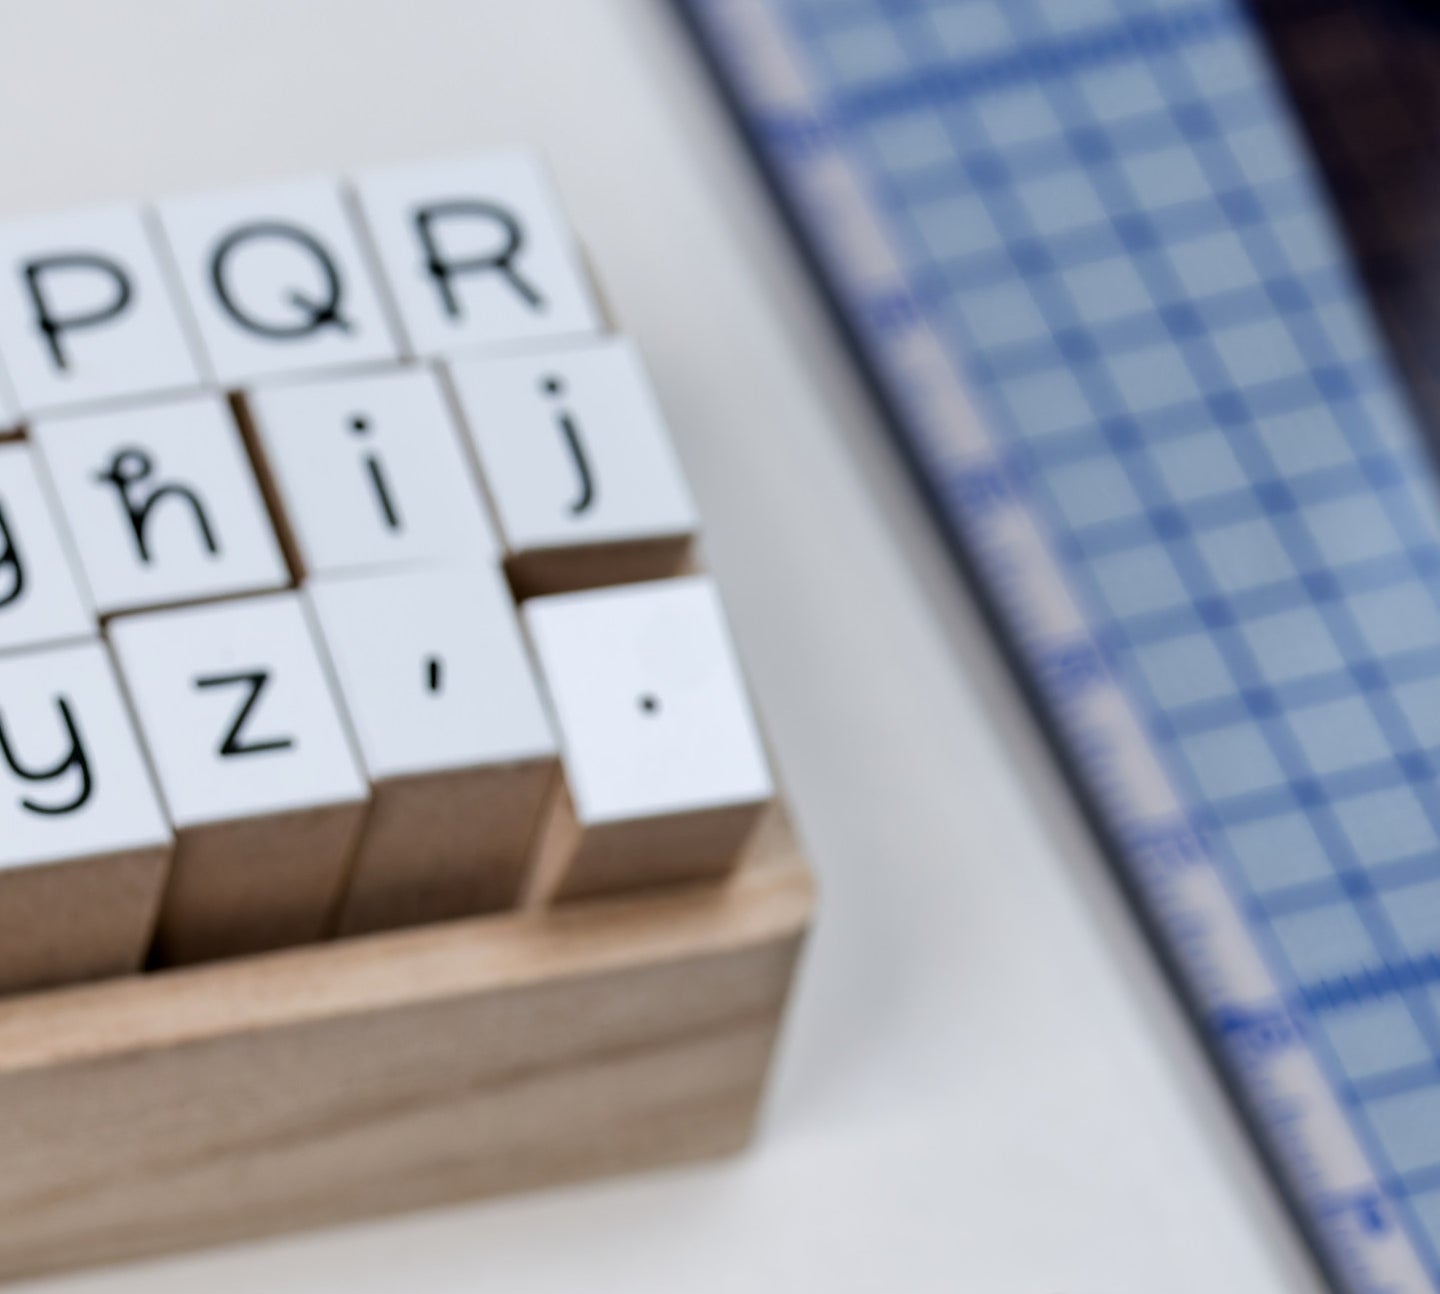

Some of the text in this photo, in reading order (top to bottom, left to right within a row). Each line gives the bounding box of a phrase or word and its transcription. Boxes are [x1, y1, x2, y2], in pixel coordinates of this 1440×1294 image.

[24, 257, 132, 369] P
[211, 228, 348, 337] Q
[415, 205, 539, 315] R
[99, 450, 217, 562] h
[352, 418, 399, 528] i
[546, 380, 594, 513] j
[196, 671, 292, 757] z
